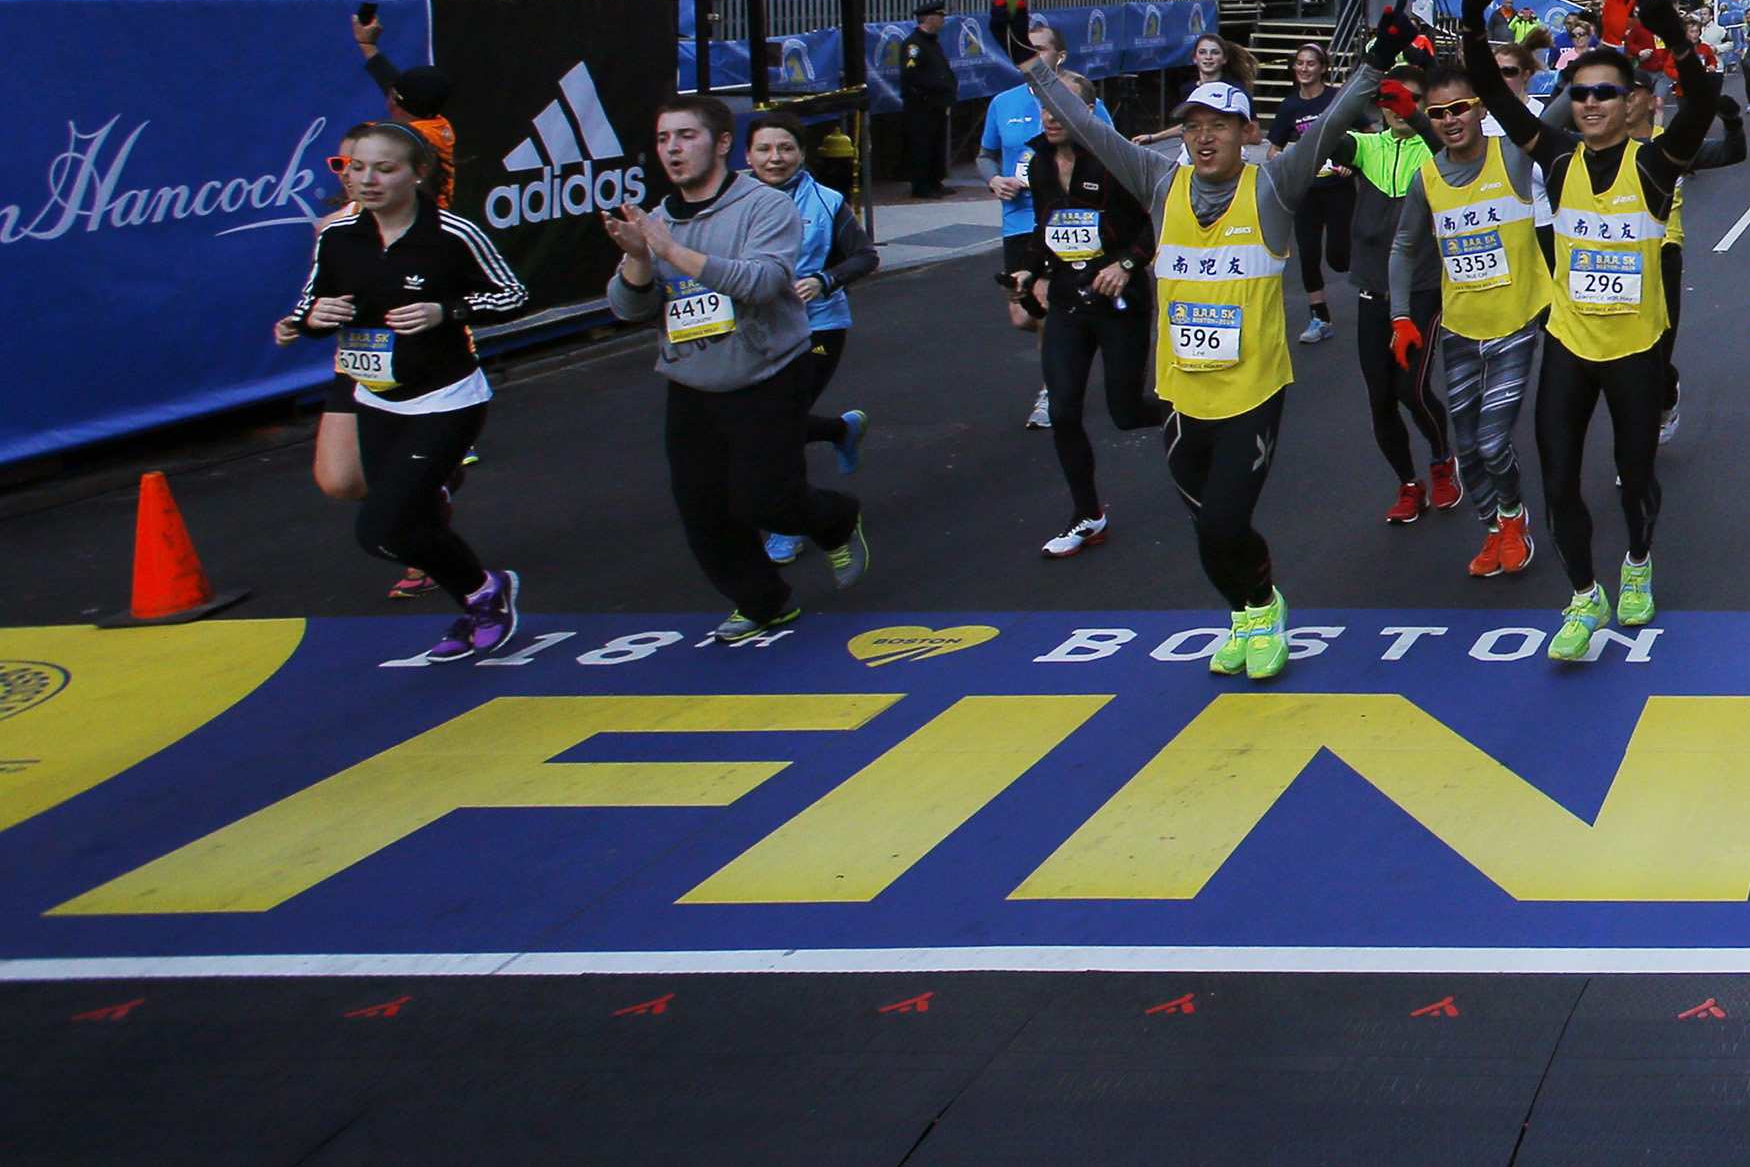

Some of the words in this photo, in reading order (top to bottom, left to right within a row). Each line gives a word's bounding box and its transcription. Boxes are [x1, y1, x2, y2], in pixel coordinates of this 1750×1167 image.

[18, 113, 327, 241] Hancock
[485, 162, 647, 230] adidas
[1051, 229, 1092, 243] 4413
[1173, 255, 1244, 275] 南跑友
[1452, 253, 1498, 274] 3353
[1585, 274, 1624, 293] 296
[669, 294, 719, 320] 4419
[1180, 328, 1220, 349] 596
[873, 636, 963, 647] BOSTON
[1033, 626, 1665, 662] BOSTON
